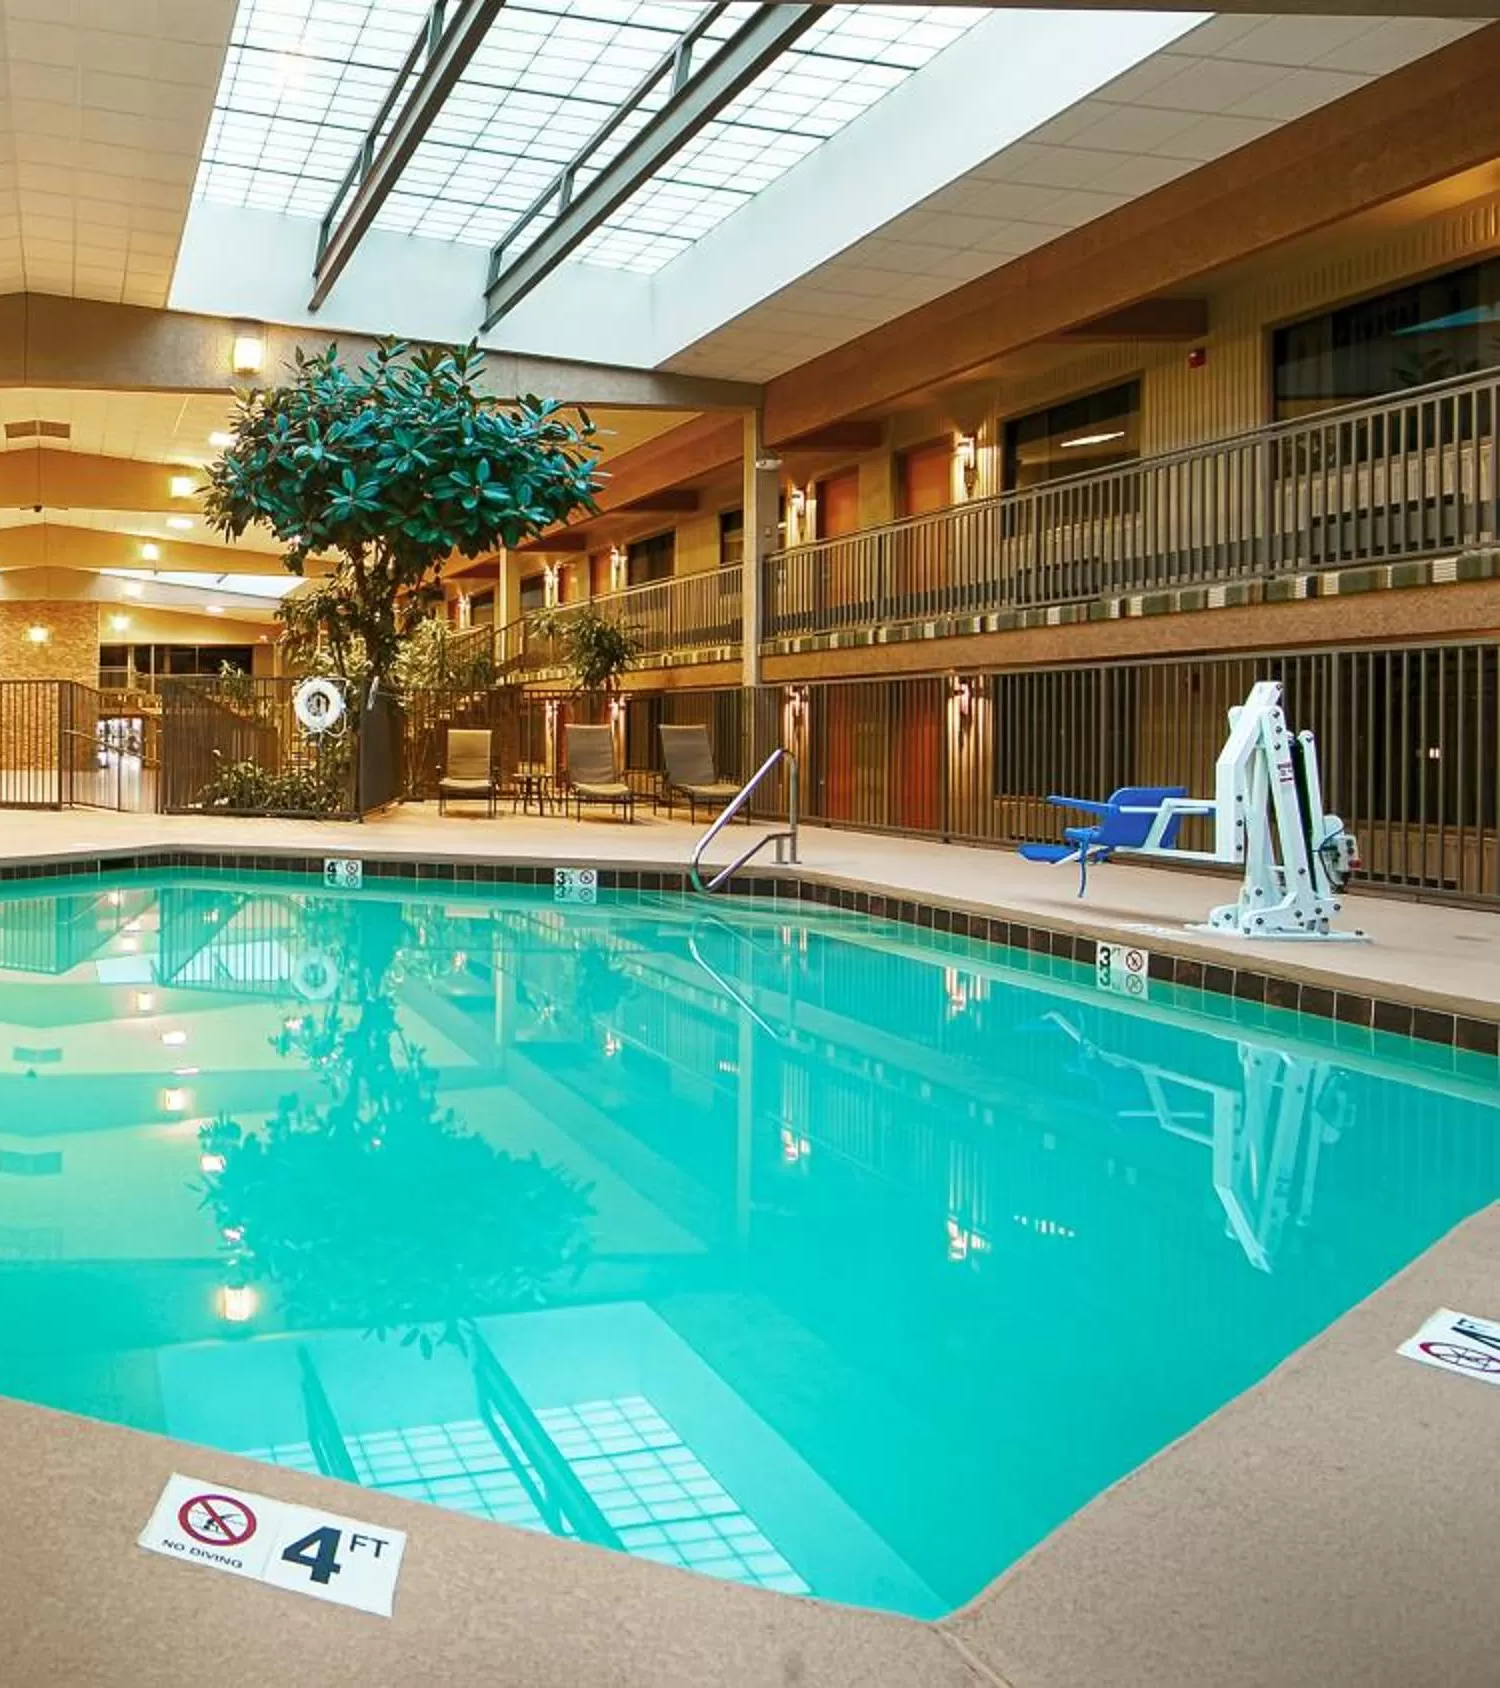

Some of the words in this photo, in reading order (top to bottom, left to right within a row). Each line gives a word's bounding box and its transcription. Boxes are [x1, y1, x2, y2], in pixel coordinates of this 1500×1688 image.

[162, 1538, 185, 1552] NO
[189, 1547, 244, 1570] DIVING
[281, 1525, 343, 1585] 4
[349, 1533, 390, 1559] FT
